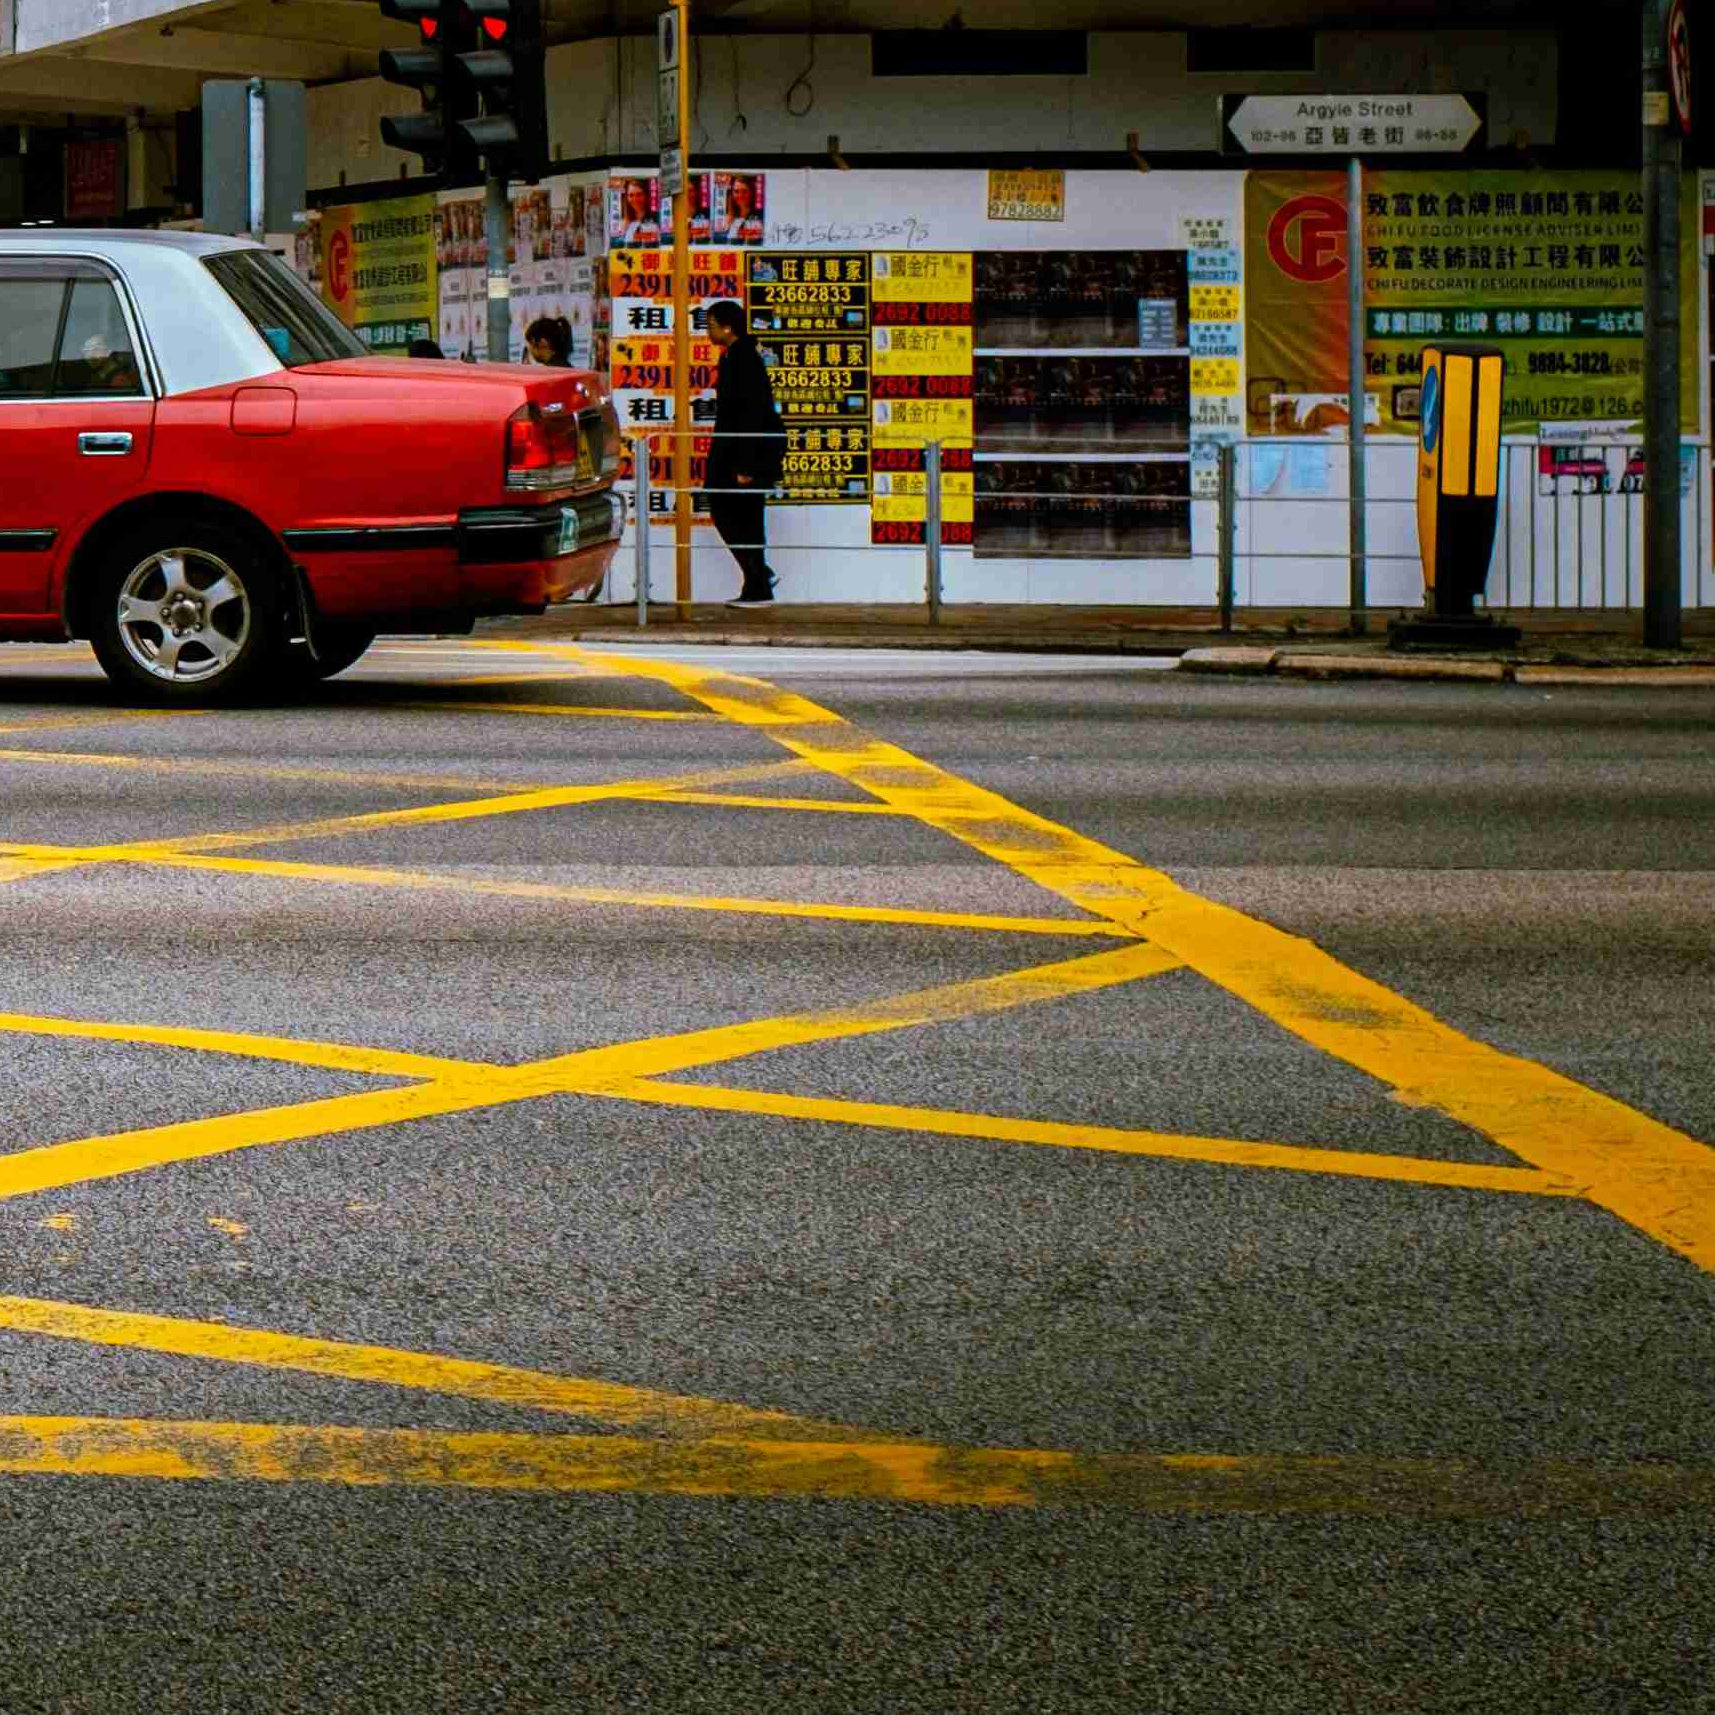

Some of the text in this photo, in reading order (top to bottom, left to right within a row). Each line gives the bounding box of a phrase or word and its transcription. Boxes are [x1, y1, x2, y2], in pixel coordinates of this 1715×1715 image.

[1297, 101, 1413, 119] Argyle Street
[1305, 126, 1404, 145] 亞皆老街
[1368, 191, 1644, 217] 致富飲食牌照顧問有限公
[1368, 244, 1644, 270] 致富裝飾設計工程有限公
[618, 274, 673, 298] 2391
[765, 286, 852, 304] 23662833
[1412, 277, 1476, 291] DECORATE
[1482, 277, 1528, 291] DESIGN
[628, 306, 668, 330] 租
[1365, 353, 1390, 376] Tel:
[619, 366, 673, 389] 2391
[767, 371, 852, 388] 23662833
[628, 397, 667, 422] 租
[619, 456, 673, 480] 291
[781, 455, 853, 472] 3662833
[890, 475, 924, 496] 國金
